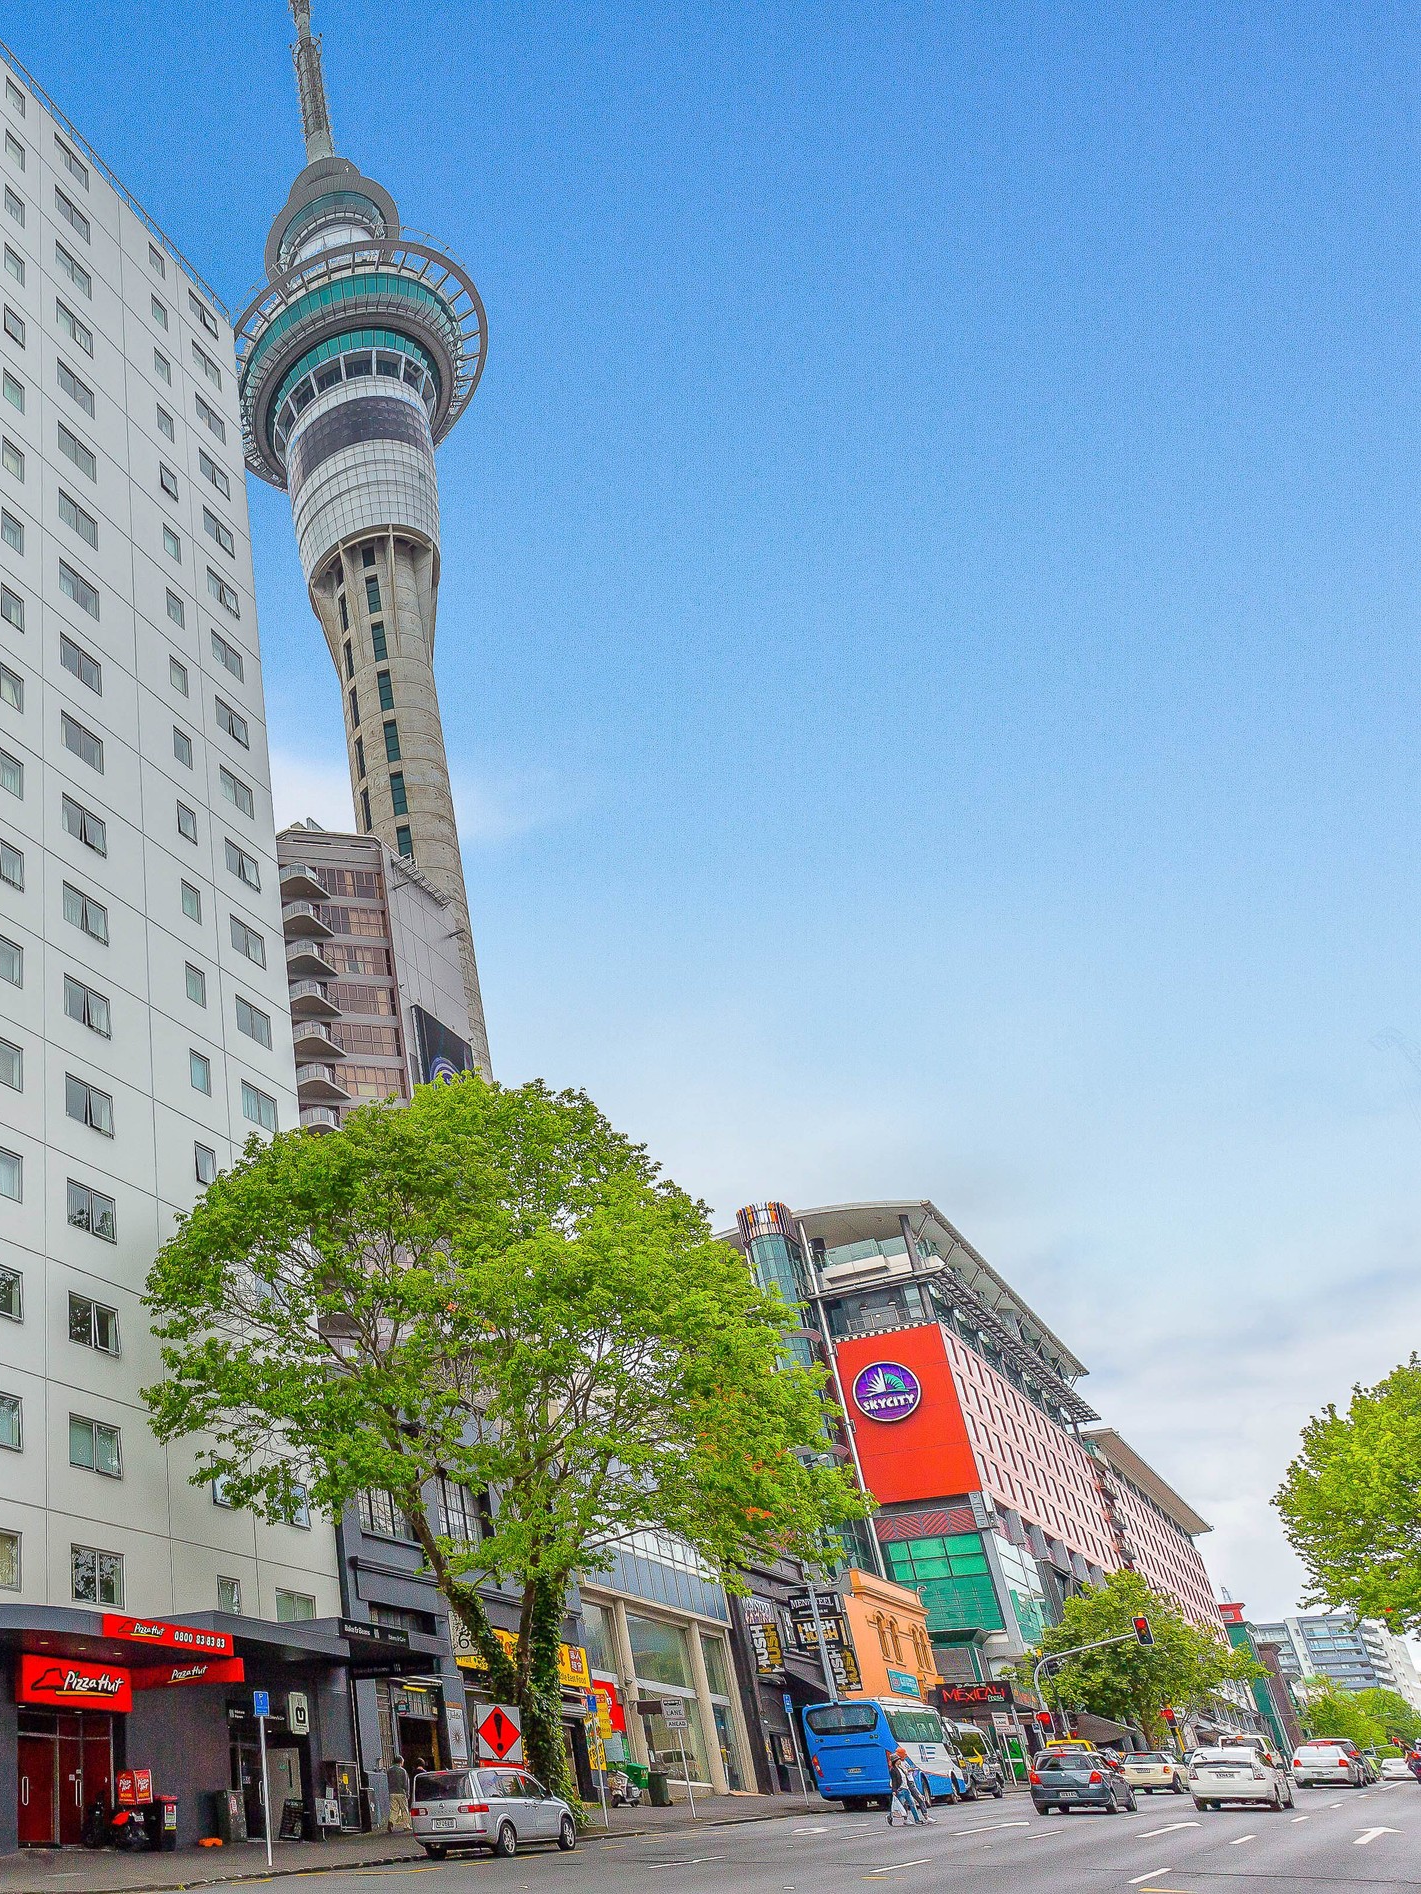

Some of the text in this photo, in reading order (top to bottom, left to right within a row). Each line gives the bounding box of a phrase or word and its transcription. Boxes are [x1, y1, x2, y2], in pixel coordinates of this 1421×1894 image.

[862, 1394, 915, 1411] SKYCITY
[133, 1622, 226, 1648] Pizza Hut 0800 83 83 83
[171, 1665, 208, 1680] Pizza Hut
[577, 1675, 586, 1684] Food
[64, 1671, 124, 1692] Pizza Hut
[942, 1686, 1005, 1703] MEXICALI
